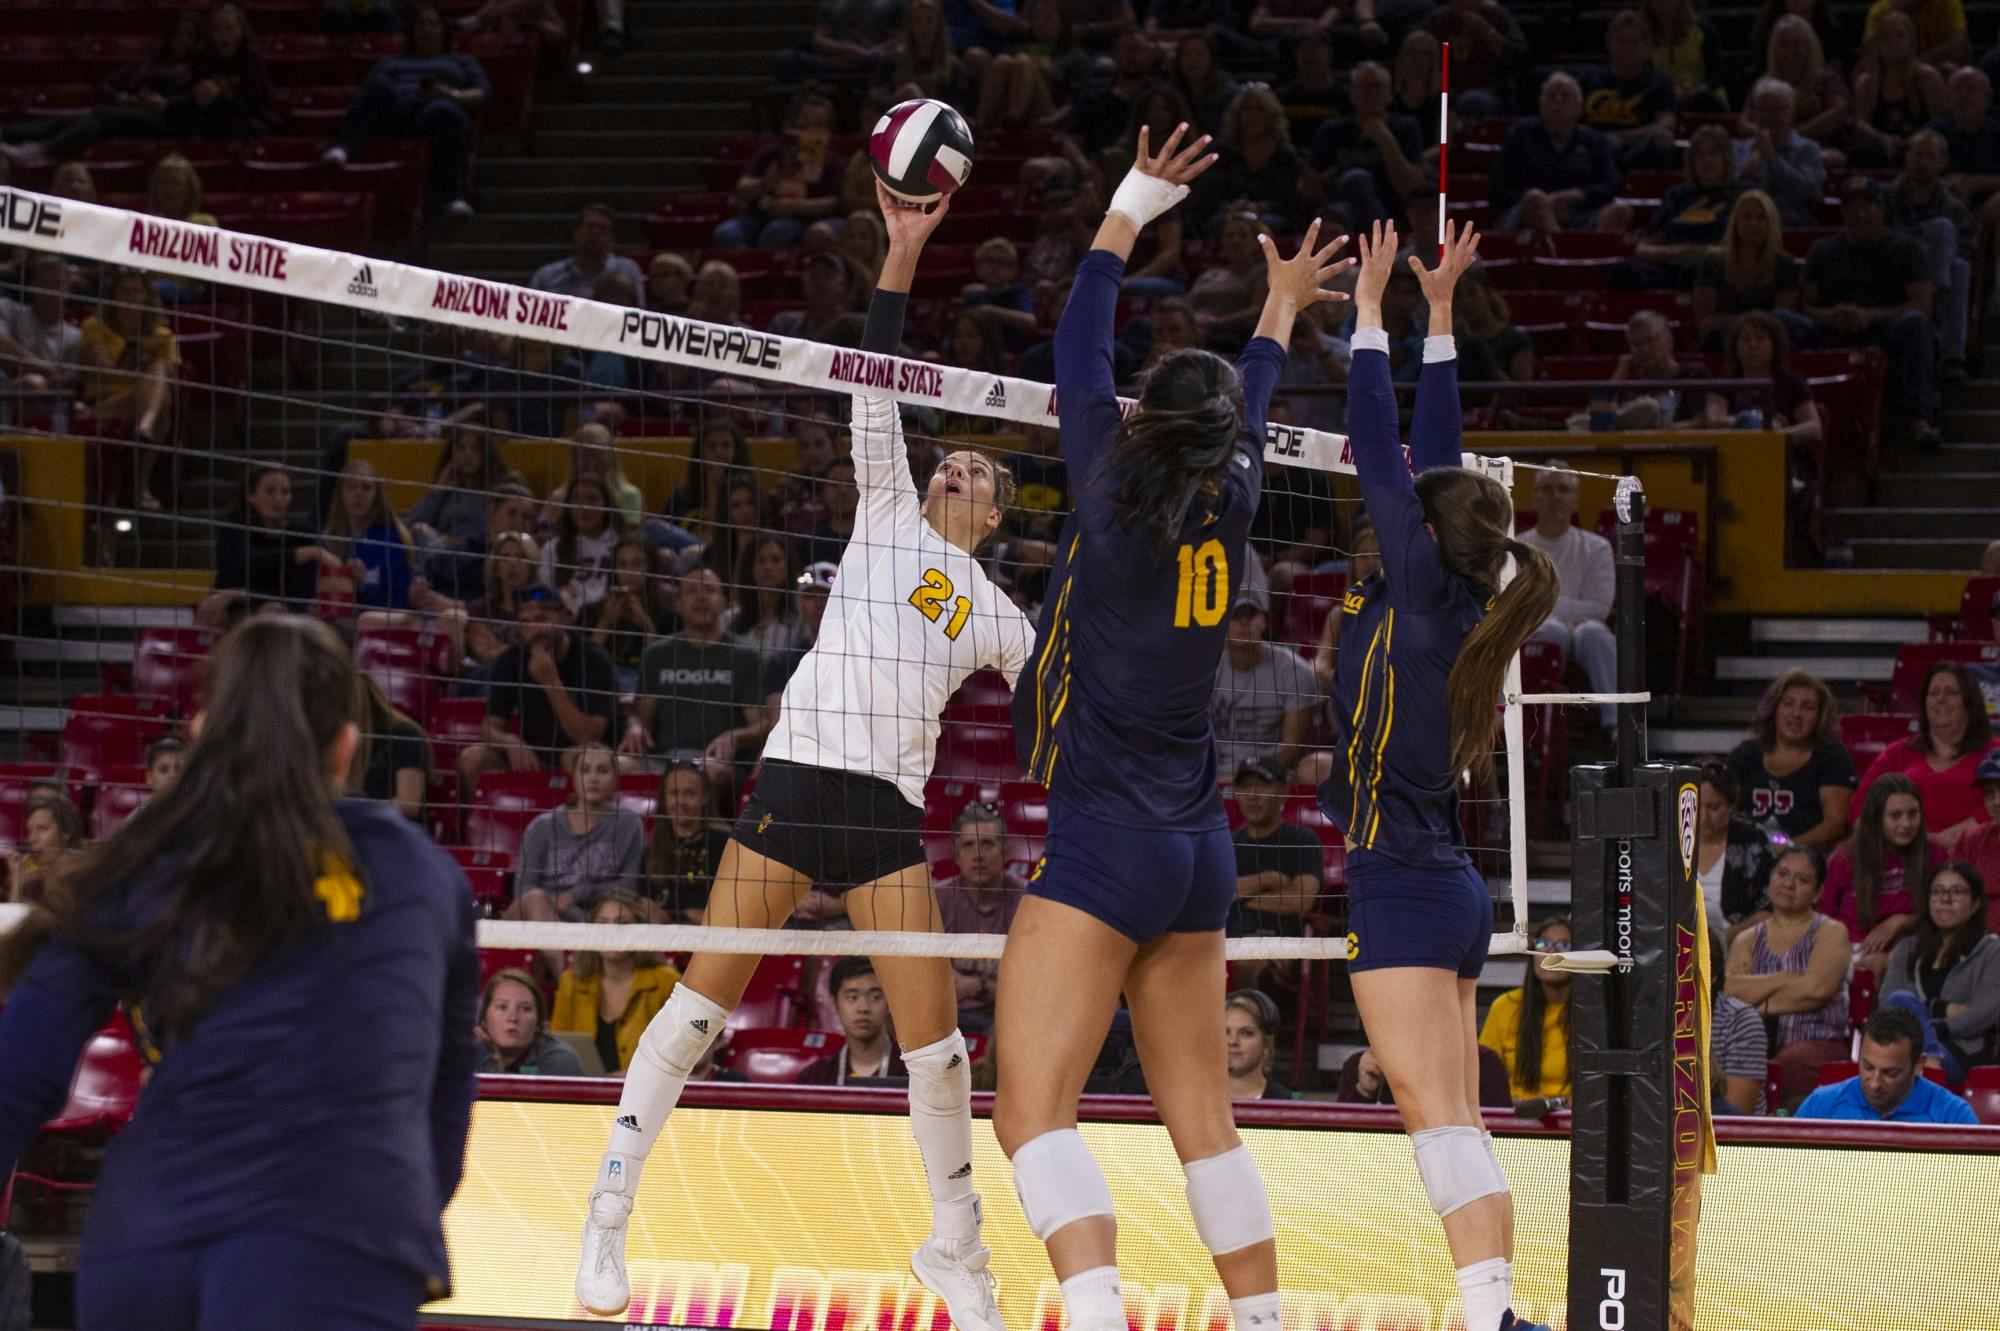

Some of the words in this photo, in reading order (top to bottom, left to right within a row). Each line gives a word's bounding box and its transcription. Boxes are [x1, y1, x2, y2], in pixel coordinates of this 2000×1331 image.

[129, 217, 219, 267] ARIZONA
[228, 236, 288, 280] STATE
[432, 276, 510, 320] ARIZONA
[515, 290, 570, 330] STATE
[619, 311, 781, 371] POWERADE
[828, 349, 895, 389] ARIZONA
[897, 362, 944, 397] STATE
[908, 568, 973, 642] 21
[1173, 537, 1229, 628] 10
[660, 668, 733, 686] ROGUE
[1616, 838, 1633, 892] ports
[1669, 922, 1700, 1281] ARIZONA
